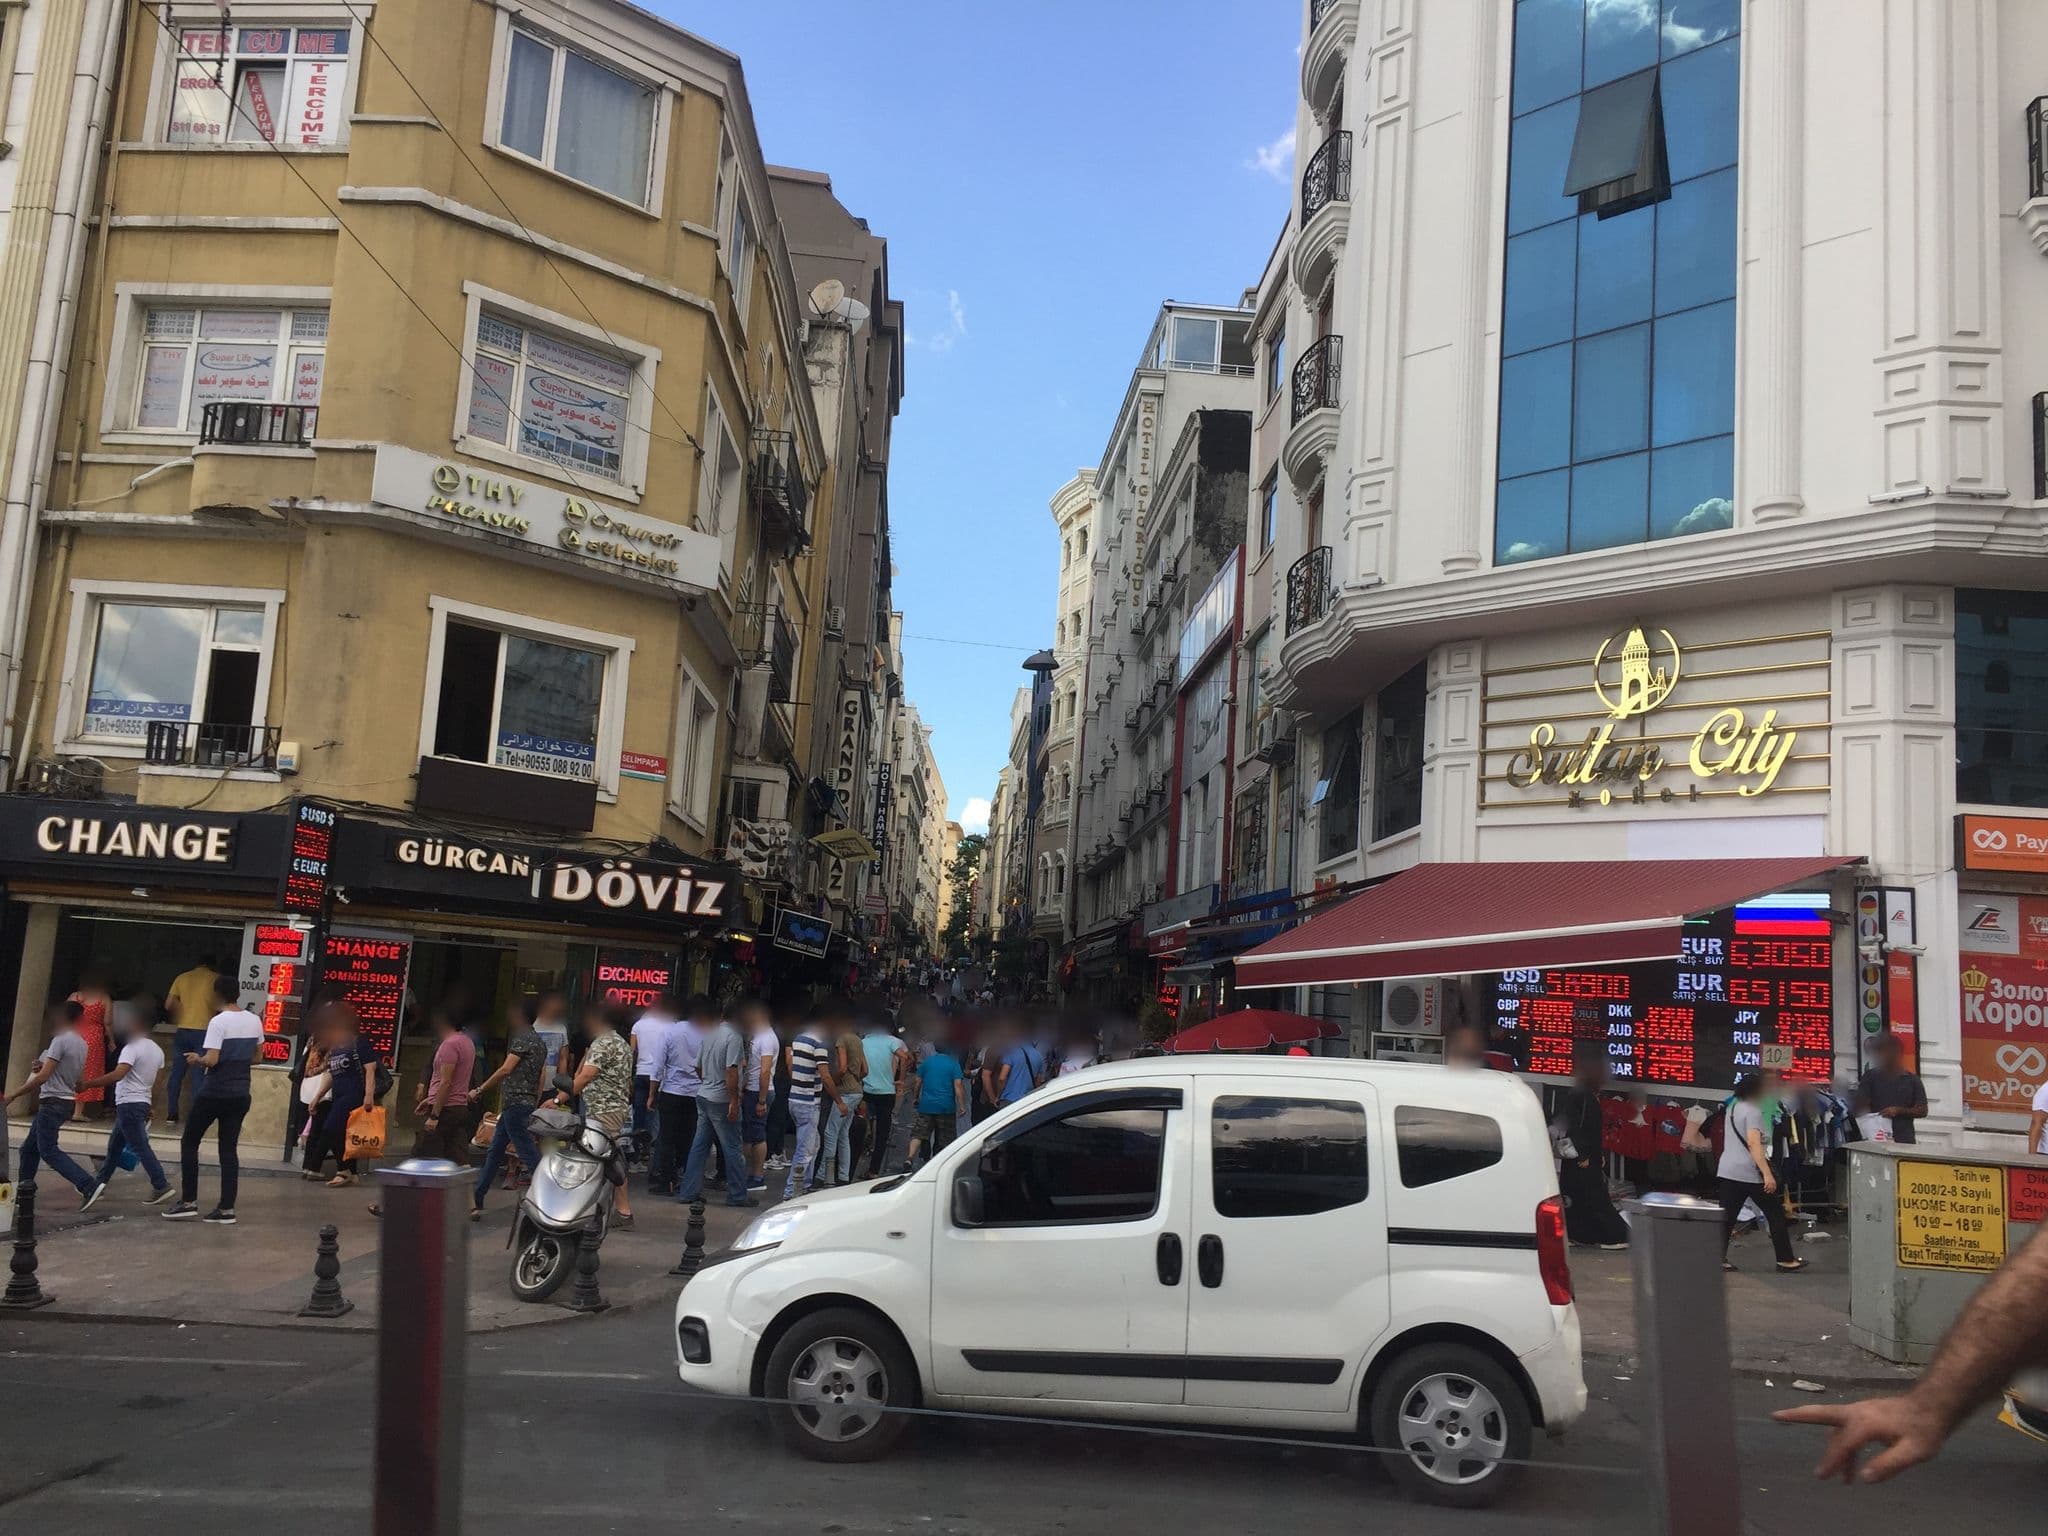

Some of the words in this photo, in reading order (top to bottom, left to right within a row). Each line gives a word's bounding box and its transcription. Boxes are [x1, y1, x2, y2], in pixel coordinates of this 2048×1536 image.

[183, 33, 232, 53] TER
[246, 30, 283, 53] CÜ
[298, 34, 335, 54] ME
[301, 63, 330, 144] TERCÜME
[488, 361, 508, 375] THY
[540, 379, 567, 394] Super
[569, 389, 586, 400] Life
[1141, 400, 1156, 475] HOTEL
[467, 473, 524, 506] THY
[425, 495, 529, 534] PEGASUS
[838, 700, 858, 783] GRAND
[1507, 722, 1664, 789] Sultan
[1689, 707, 1798, 797] City
[505, 751, 551, 772] Tel:+90555
[553, 758, 568, 774] 088
[570, 762, 580, 777] 92
[582, 763, 592, 778] 00
[880, 764, 890, 804] HOTEL
[875, 808, 887, 846] HAMZA
[37, 817, 231, 863] CHANGE
[398, 838, 530, 877] GÜRCAN
[553, 859, 727, 916] DÖVİZ
[1681, 937, 1723, 955] EUR
[352, 960, 370, 970] NO
[1705, 956, 1725, 965] BUY
[599, 965, 669, 985] EXCHANGE
[1503, 968, 1540, 983] USD
[1678, 973, 1723, 991] EUR
[241, 980, 265, 992] DOLAR
[1498, 983, 1518, 993] SATIŞ
[1525, 985, 1545, 993] SELL
[1672, 990, 1696, 1002] SATIŞ
[1705, 992, 1728, 1002] SELL
[1497, 999, 1519, 1010] GBP
[1608, 1004, 1632, 1017] DKK
[1498, 1017, 1519, 1029] CHF
[1735, 1011, 1760, 1024] JPY
[1608, 1023, 1632, 1036] AUD
[1733, 1031, 1761, 1045] RUB
[1608, 1043, 1632, 1056] CAD
[1766, 1048, 1782, 1063] 10
[1734, 1052, 1761, 1066] AZN
[1610, 1063, 1633, 1076] SAR
[1954, 1169, 1977, 1182] Tarih
[1980, 1174, 1990, 1183] ve
[1910, 1183, 1957, 1197] 2008/2-8
[1960, 1186, 1992, 1201] Sayılı
[1903, 1198, 1947, 1212] UKOME
[1950, 1201, 1985, 1215] Kararı
[1987, 1203, 2001, 1216] ile
[1924, 1233, 1956, 1246] Saatleri
[1958, 1237, 1980, 1249] Arası
[1926, 1248, 1962, 1264] Trafiğine
